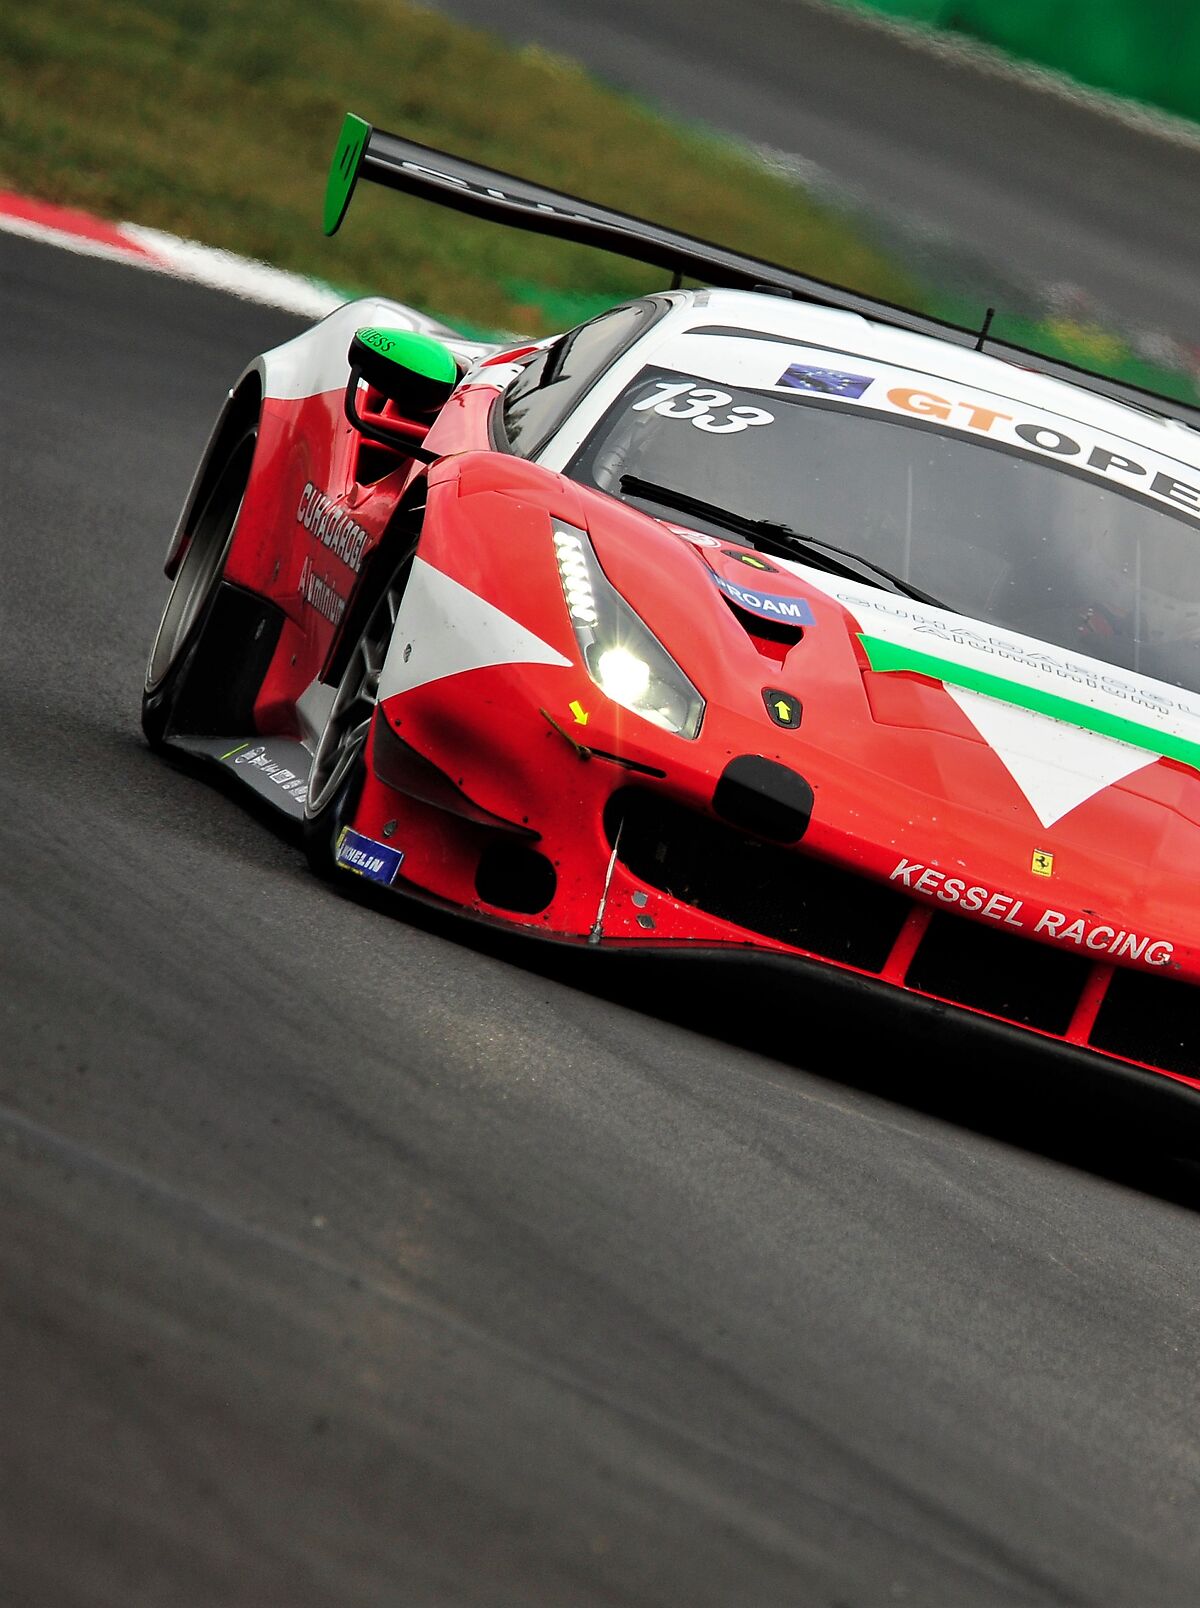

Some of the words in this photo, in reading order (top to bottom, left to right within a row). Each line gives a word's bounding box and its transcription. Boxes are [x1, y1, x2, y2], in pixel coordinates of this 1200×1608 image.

[632, 382, 775, 434] 133
[296, 482, 372, 574] CUHADAROGL
[889, 858, 1025, 928] KESSEL
[1033, 909, 1175, 967] RACING
